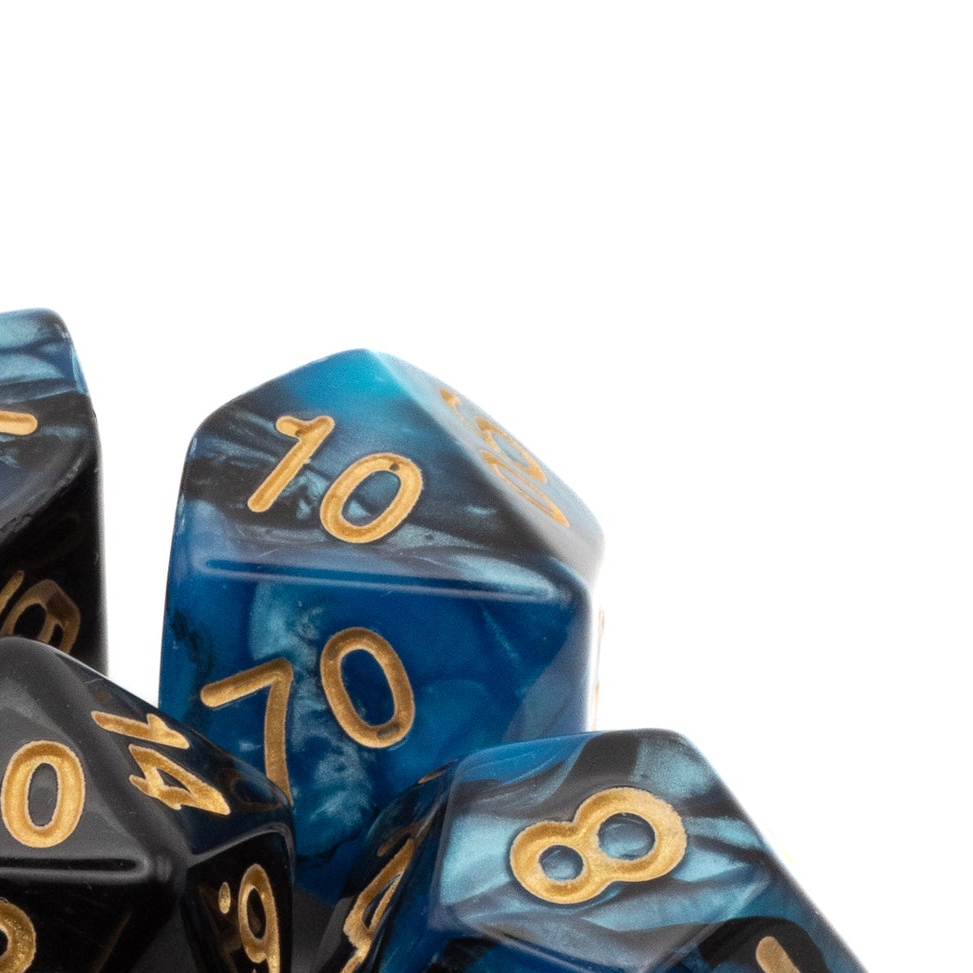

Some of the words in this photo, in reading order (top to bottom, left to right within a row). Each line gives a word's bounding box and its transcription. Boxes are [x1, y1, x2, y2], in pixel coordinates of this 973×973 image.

[245, 415, 423, 545] 10
[92, 710, 231, 816] 14
[201, 628, 414, 798] 70
[511, 785, 686, 904] 8
